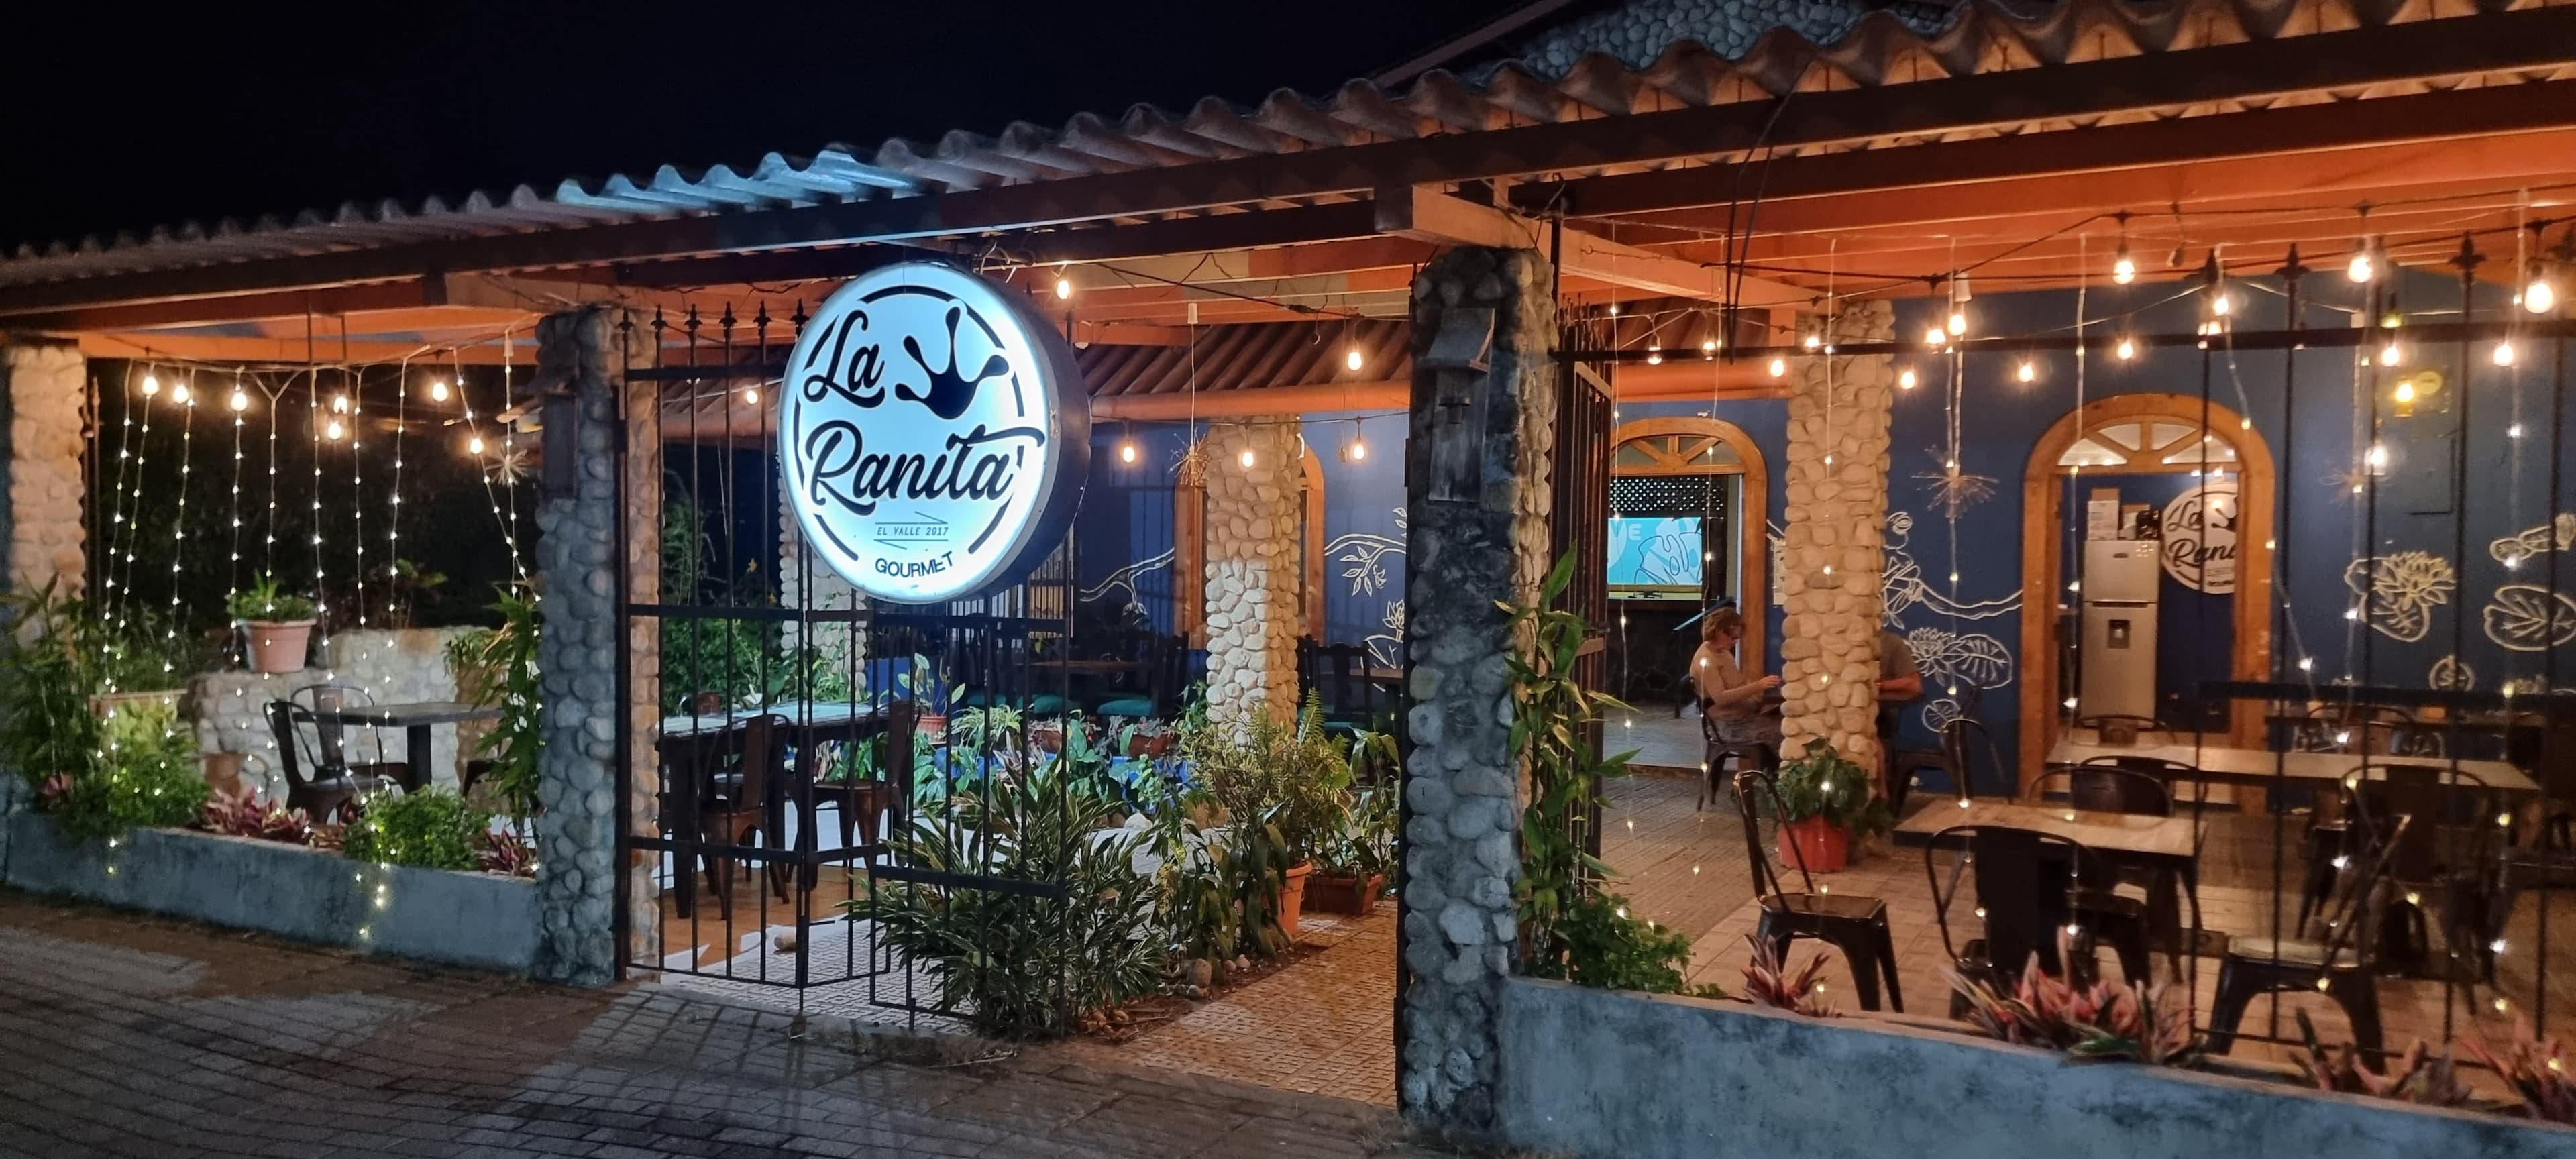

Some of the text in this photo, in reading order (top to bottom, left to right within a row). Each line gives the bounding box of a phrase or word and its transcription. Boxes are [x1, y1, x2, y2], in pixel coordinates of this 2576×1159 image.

[804, 309, 885, 408] La
[805, 420, 1046, 516] Ranita
[877, 527, 949, 535] EL VALLE 2017
[875, 550, 953, 578] GOURMET
